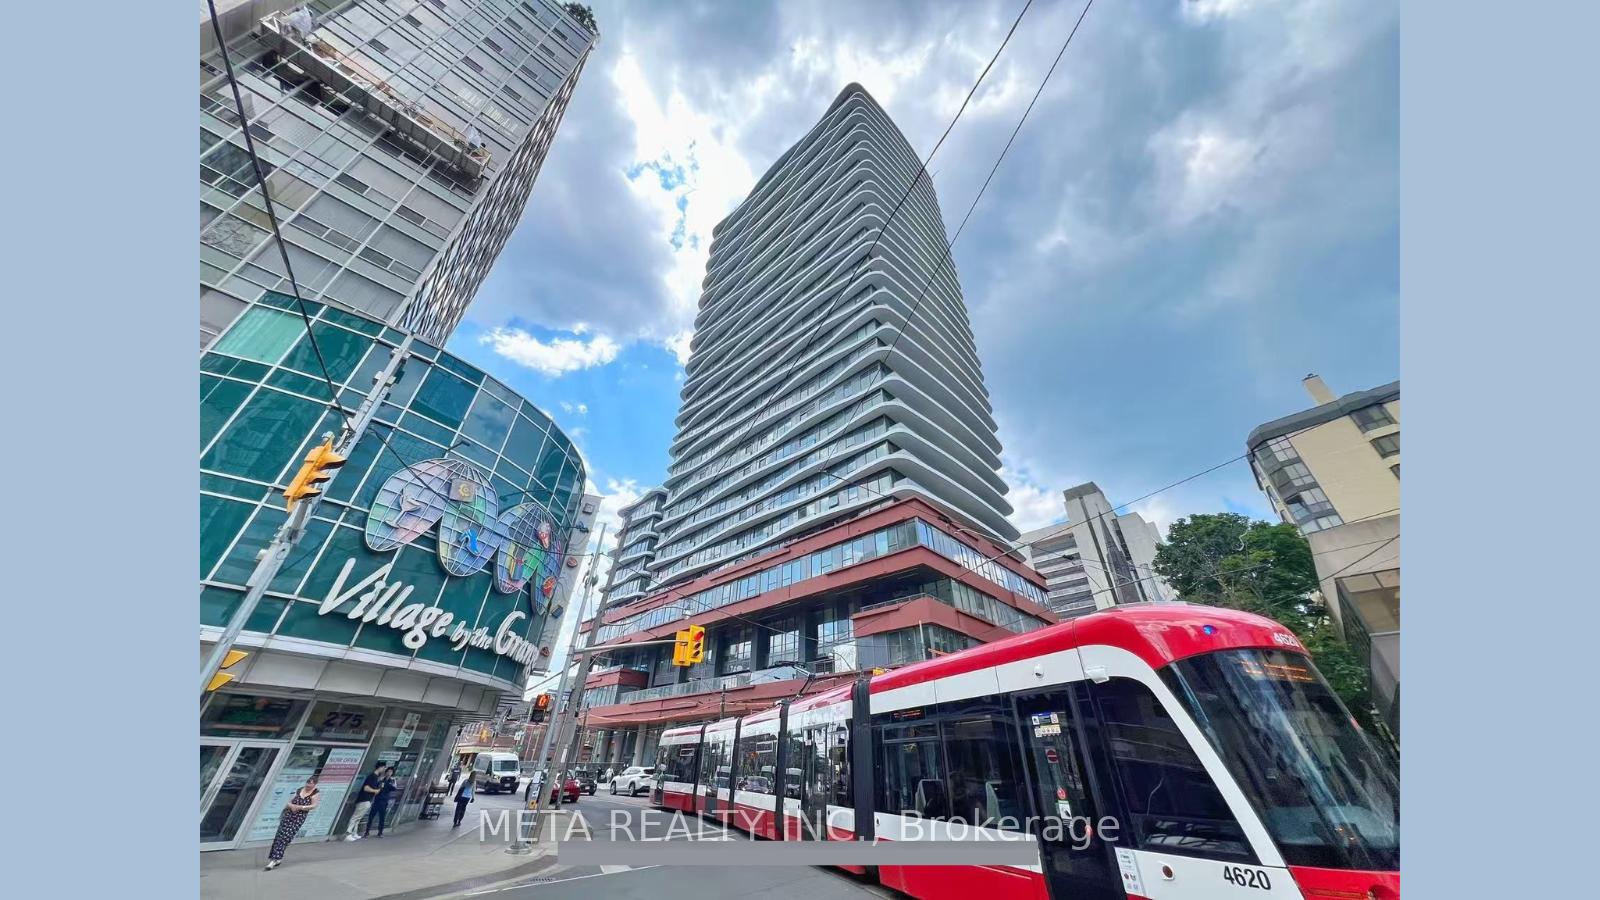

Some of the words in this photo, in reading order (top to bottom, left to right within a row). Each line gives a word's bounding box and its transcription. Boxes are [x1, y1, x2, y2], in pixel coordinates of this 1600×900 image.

[318, 558, 454, 650] Village
[449, 620, 470, 652] by
[469, 625, 493, 649] the
[323, 711, 365, 728] 275
[1223, 865, 1272, 891] 4620
